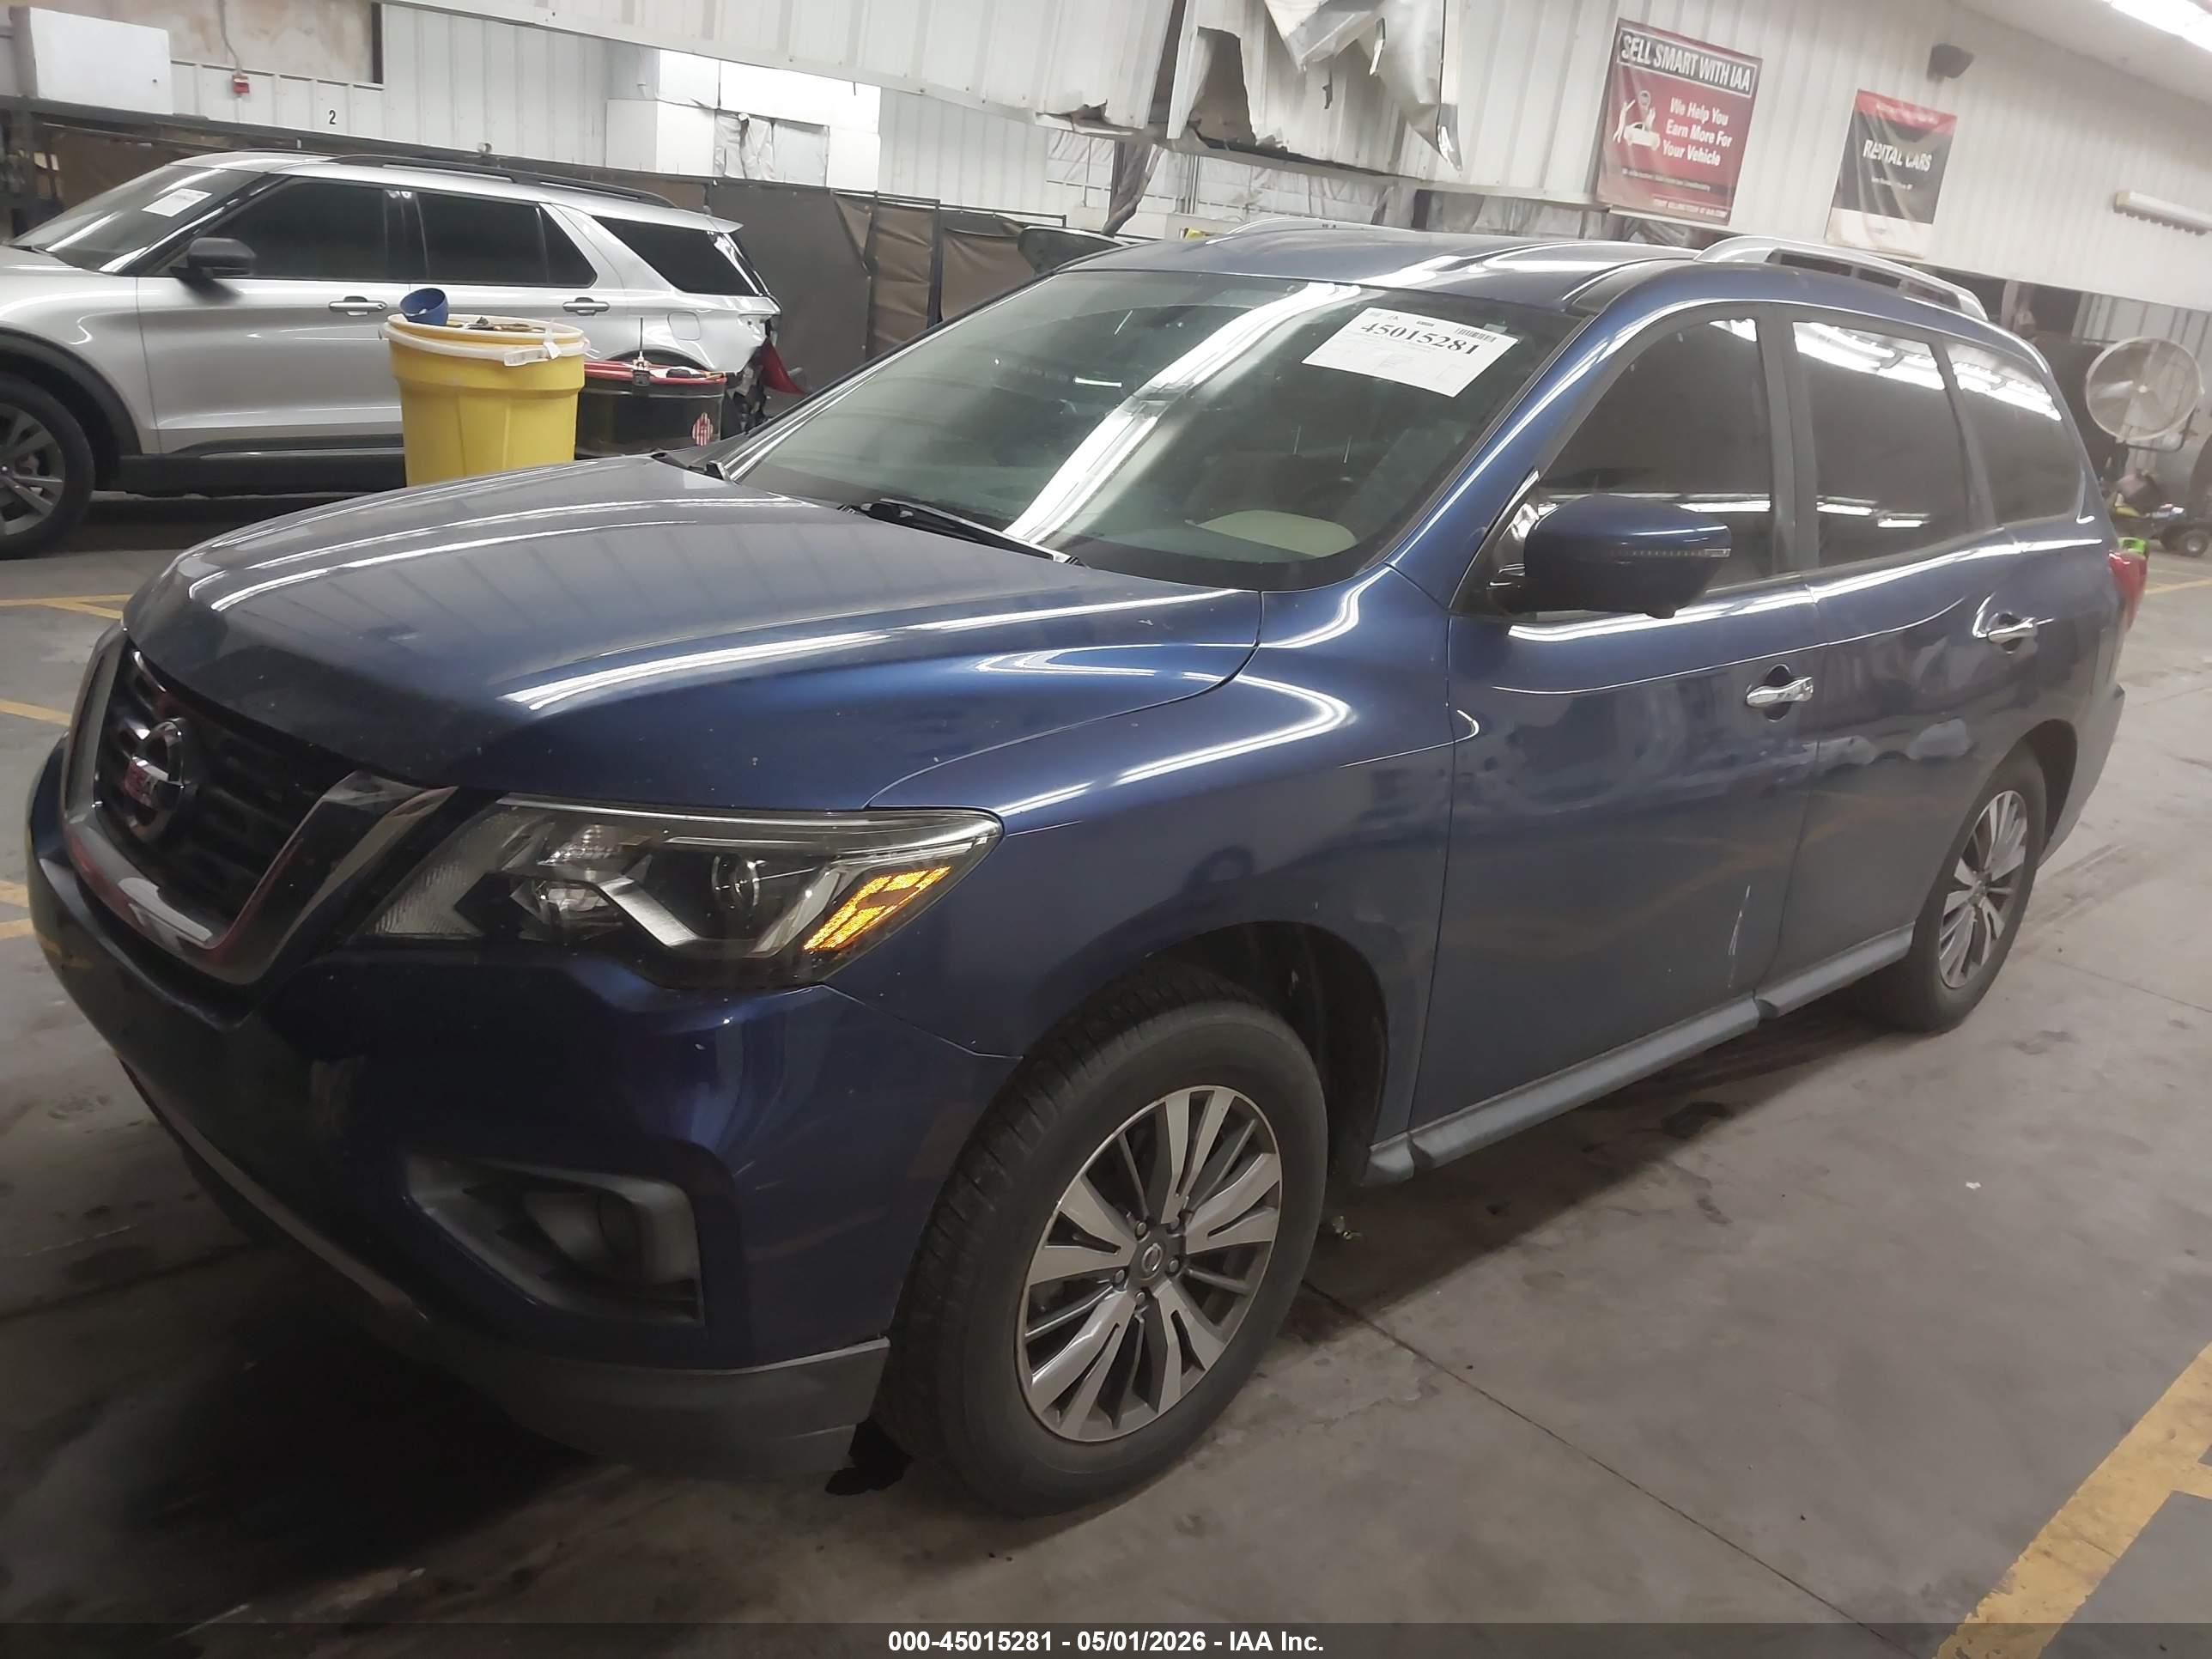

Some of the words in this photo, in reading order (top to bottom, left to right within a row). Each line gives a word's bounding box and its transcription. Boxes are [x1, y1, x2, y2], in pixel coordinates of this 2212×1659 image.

[1621, 34, 1651, 64] SELL
[1654, 44, 1698, 76] SMART
[1698, 58, 1729, 85] WITH
[1729, 66, 1752, 92] IAA
[329, 109, 337, 125] 2
[1670, 97, 1686, 116] We
[1686, 101, 1710, 124] Help
[1711, 107, 1729, 125] You
[1666, 118, 1689, 137] Earn
[1690, 124, 1716, 143] More
[1716, 131, 1733, 148] For
[1662, 139, 1686, 158] Your
[1687, 143, 1721, 167] Vehicle
[1863, 138, 1903, 166] RENTAL
[1905, 153, 1933, 173] CARS
[1361, 322, 1480, 355] 45015281
